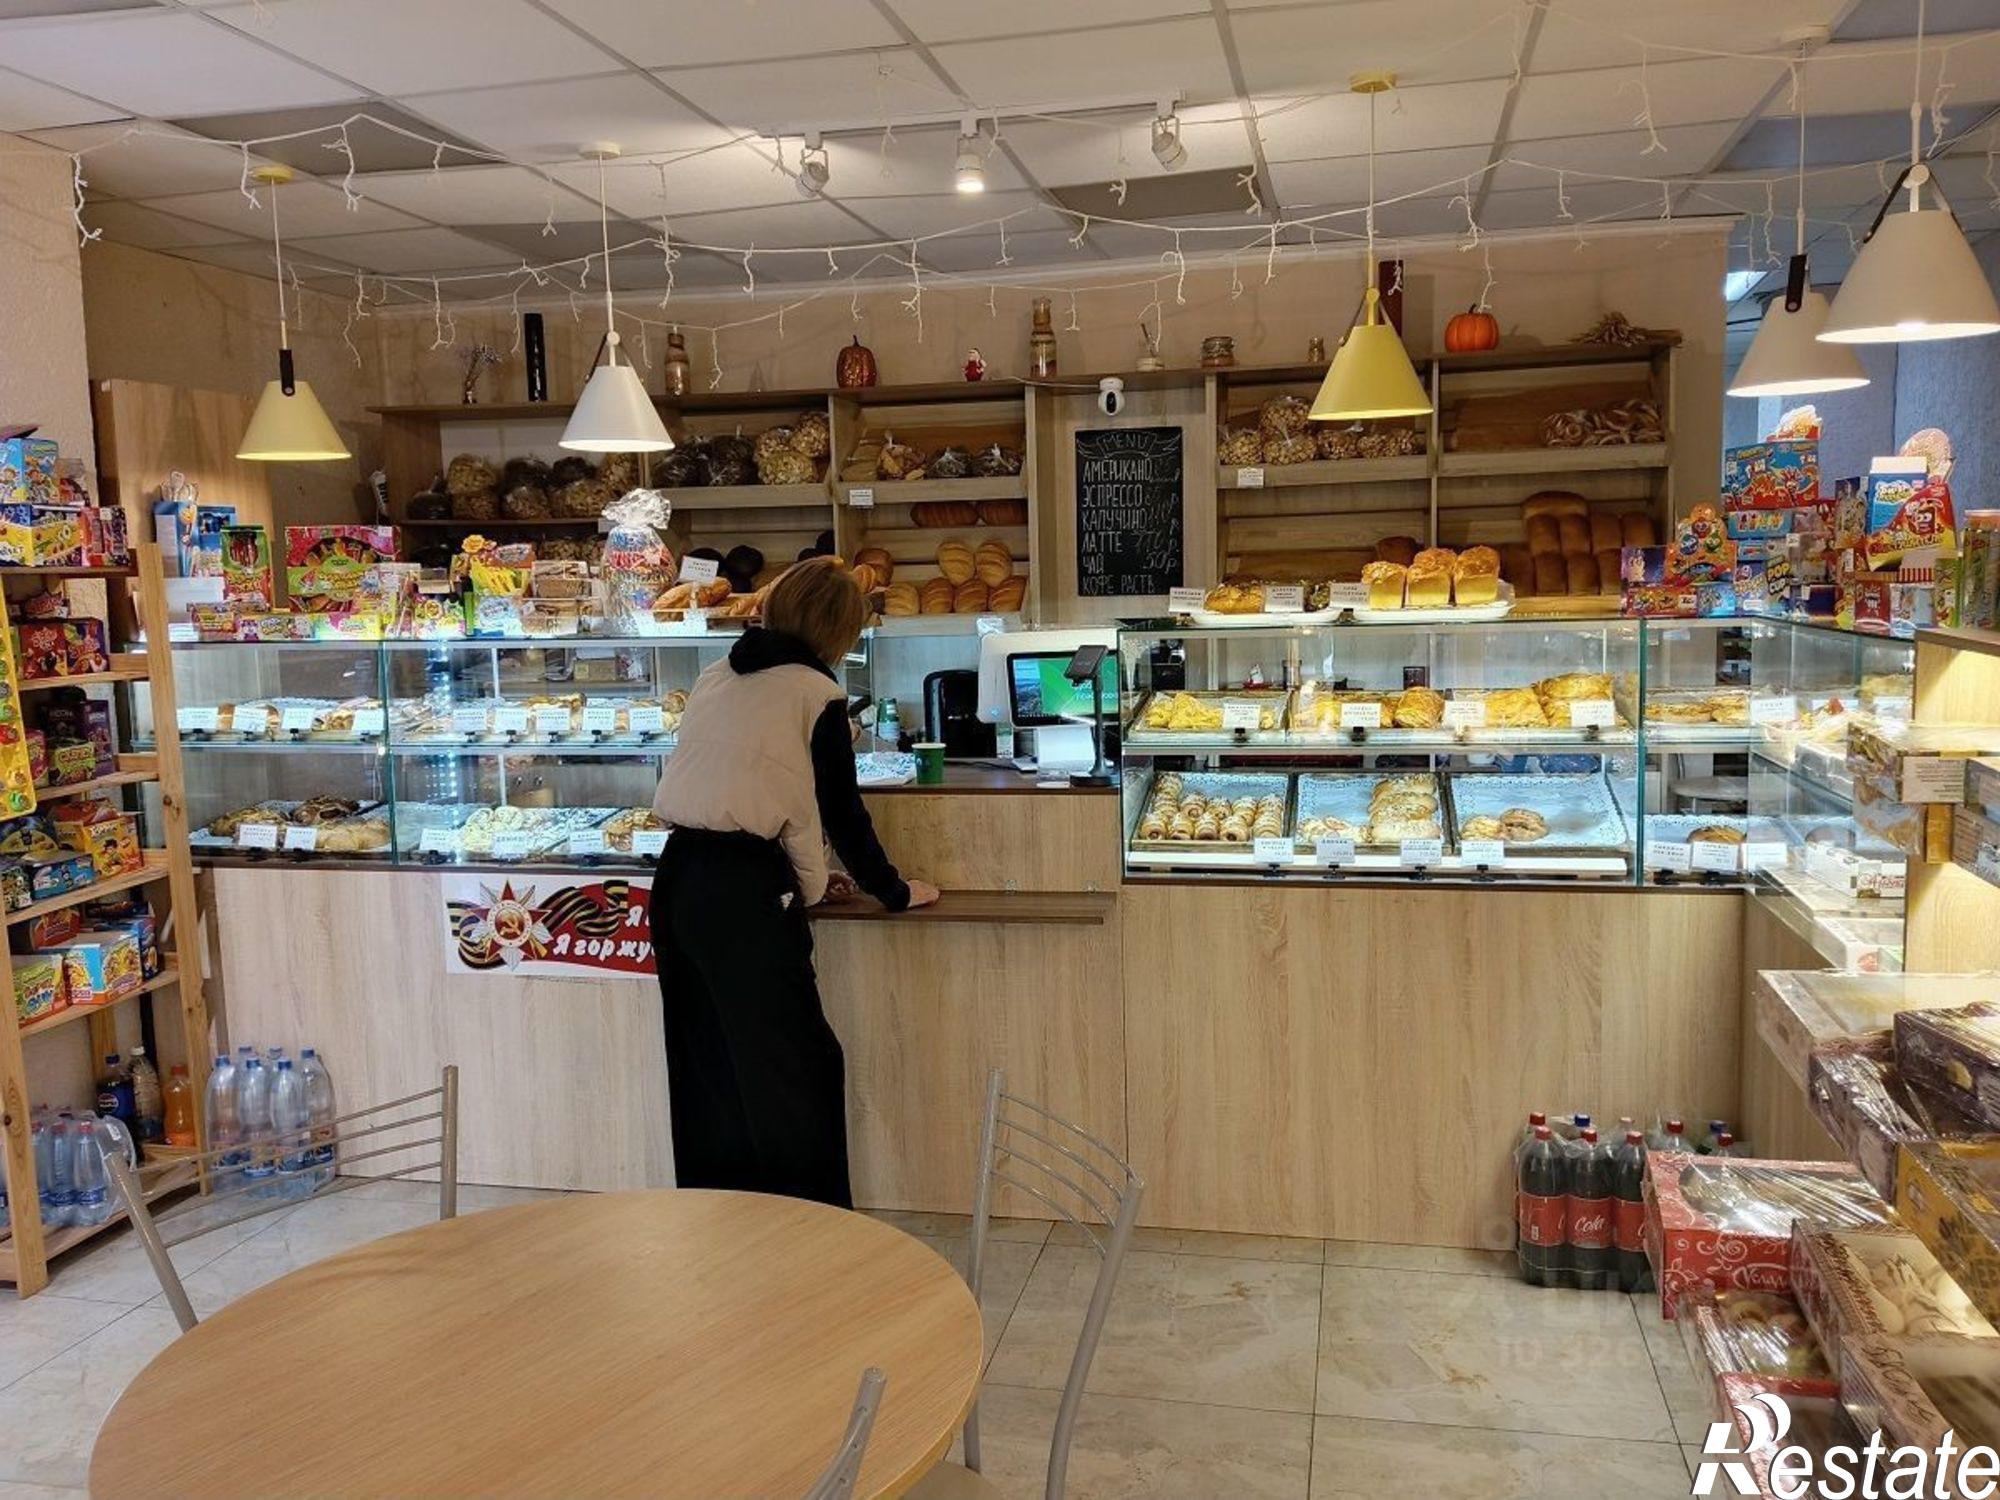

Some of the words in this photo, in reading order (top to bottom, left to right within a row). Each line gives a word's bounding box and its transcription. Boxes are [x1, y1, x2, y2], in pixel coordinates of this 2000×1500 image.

[1083, 459, 1152, 482] АМЕРИКАНО
[1082, 484, 1142, 507] ЭСПРЕССО
[1082, 508, 1147, 531] КАПУЧИНО
[1082, 531, 1122, 553] ЛАТТЕ
[1083, 553, 1104, 574] ЧАЙ
[1082, 574, 1115, 595] КОФЕ
[626, 906, 643, 926] Я
[554, 934, 571, 955] Я
[575, 938, 655, 963] горжу
